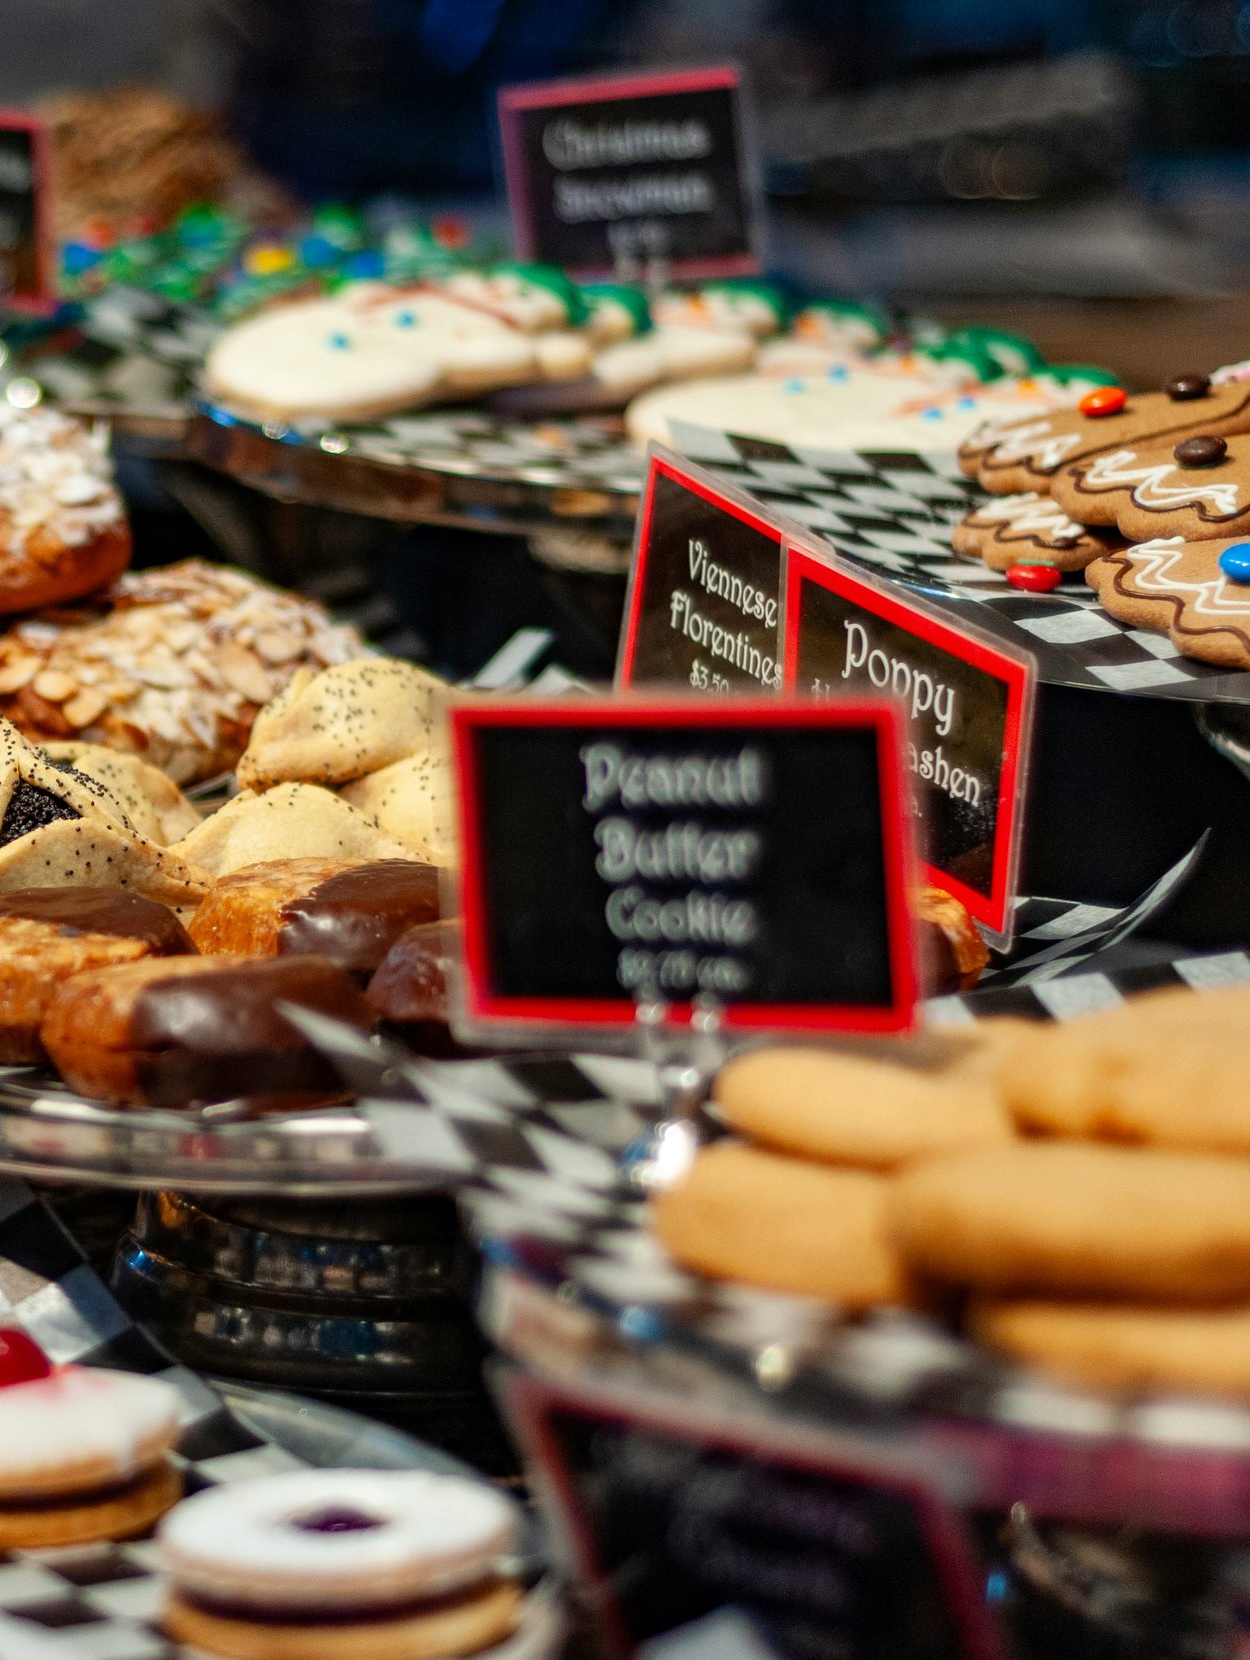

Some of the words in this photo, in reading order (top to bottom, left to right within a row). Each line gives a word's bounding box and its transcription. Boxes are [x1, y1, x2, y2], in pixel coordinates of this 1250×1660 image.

[688, 539, 777, 629] Viennese
[669, 590, 783, 690] Florentines
[842, 620, 956, 736] Poppy
[580, 743, 764, 811] Peanut
[907, 743, 981, 808] ashen
[595, 817, 758, 883] Butter
[606, 887, 755, 944] Cookie
